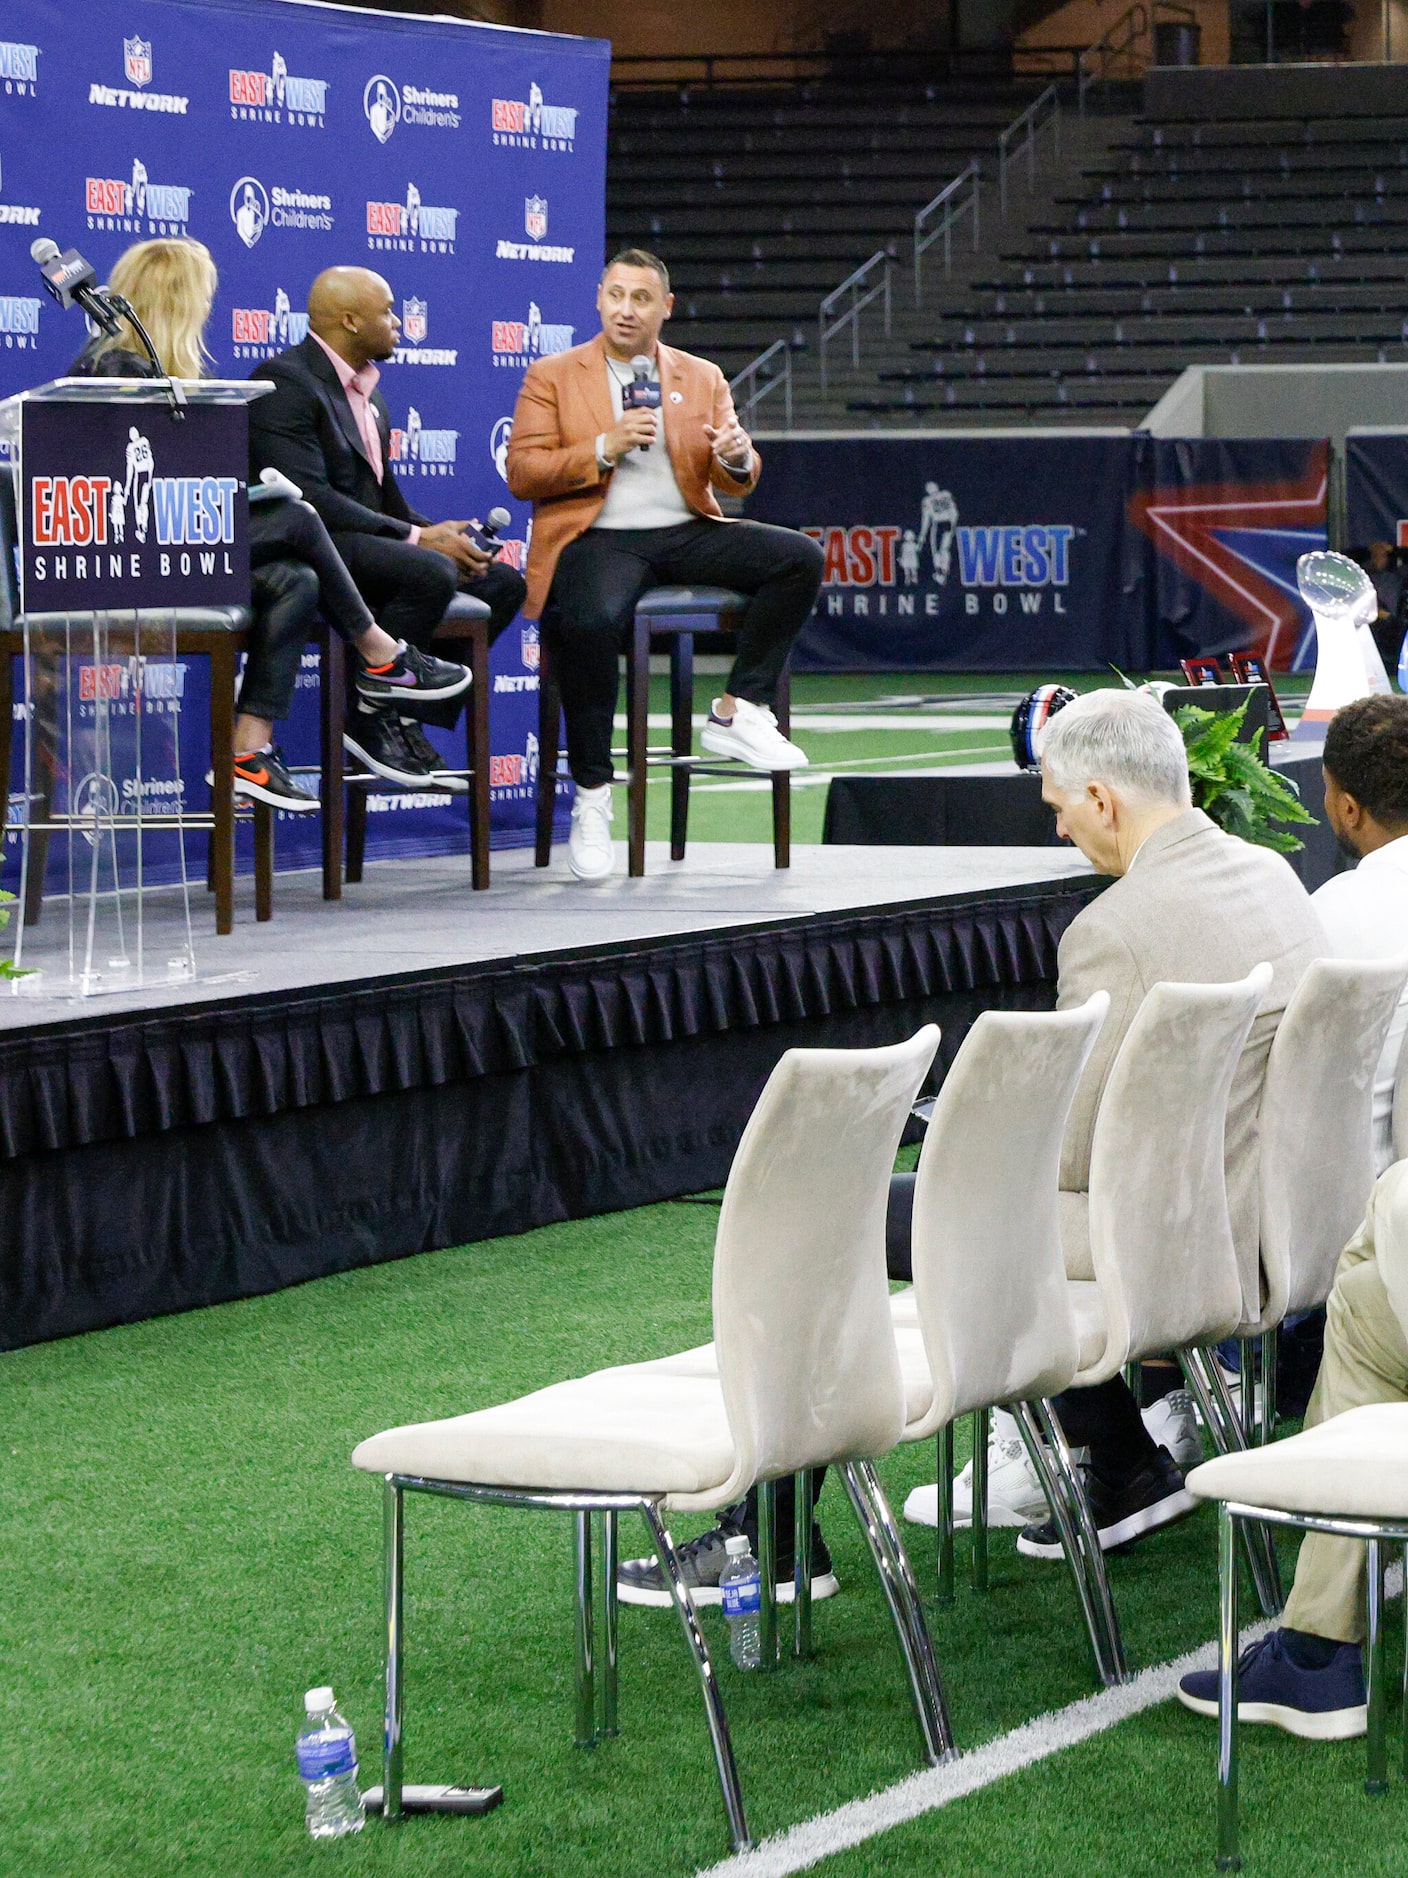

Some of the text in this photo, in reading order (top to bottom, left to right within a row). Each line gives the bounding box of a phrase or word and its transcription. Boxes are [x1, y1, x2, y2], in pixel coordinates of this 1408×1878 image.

[128, 57, 149, 78] NFL
[5, 80, 36, 97] OWL
[89, 83, 189, 114] NETWORK
[229, 69, 327, 113] EAST WEST
[403, 85, 459, 108] Shriners
[231, 106, 325, 128] SHRINE BOWL
[403, 105, 462, 128] Children's
[492, 99, 577, 139] EAST WEST
[493, 133, 573, 153] SHRINE BOWL
[86, 177, 190, 222] EAST WEST
[271, 186, 332, 210] Shriners
[87, 215, 189, 237] SHRINE BOWL
[271, 207, 333, 231] Children's
[367, 201, 457, 240] EAST WEST
[368, 236, 455, 254] SHRINE BOWL
[496, 240, 575, 263] NETWORK
[233, 308, 269, 343] EAST
[492, 321, 524, 353] EAST
[5, 335, 37, 350] OWL
[419, 430, 458, 462] WEST
[421, 464, 455, 477] BOWL
[32, 475, 239, 546] EAST WEST
[34, 551, 234, 580] SHRINE BOWL
[956, 524, 1075, 587] WEST
[965, 593, 1067, 615] BOWL
[490, 754, 522, 786] EAST
[490, 787, 534, 801] SHRINE
